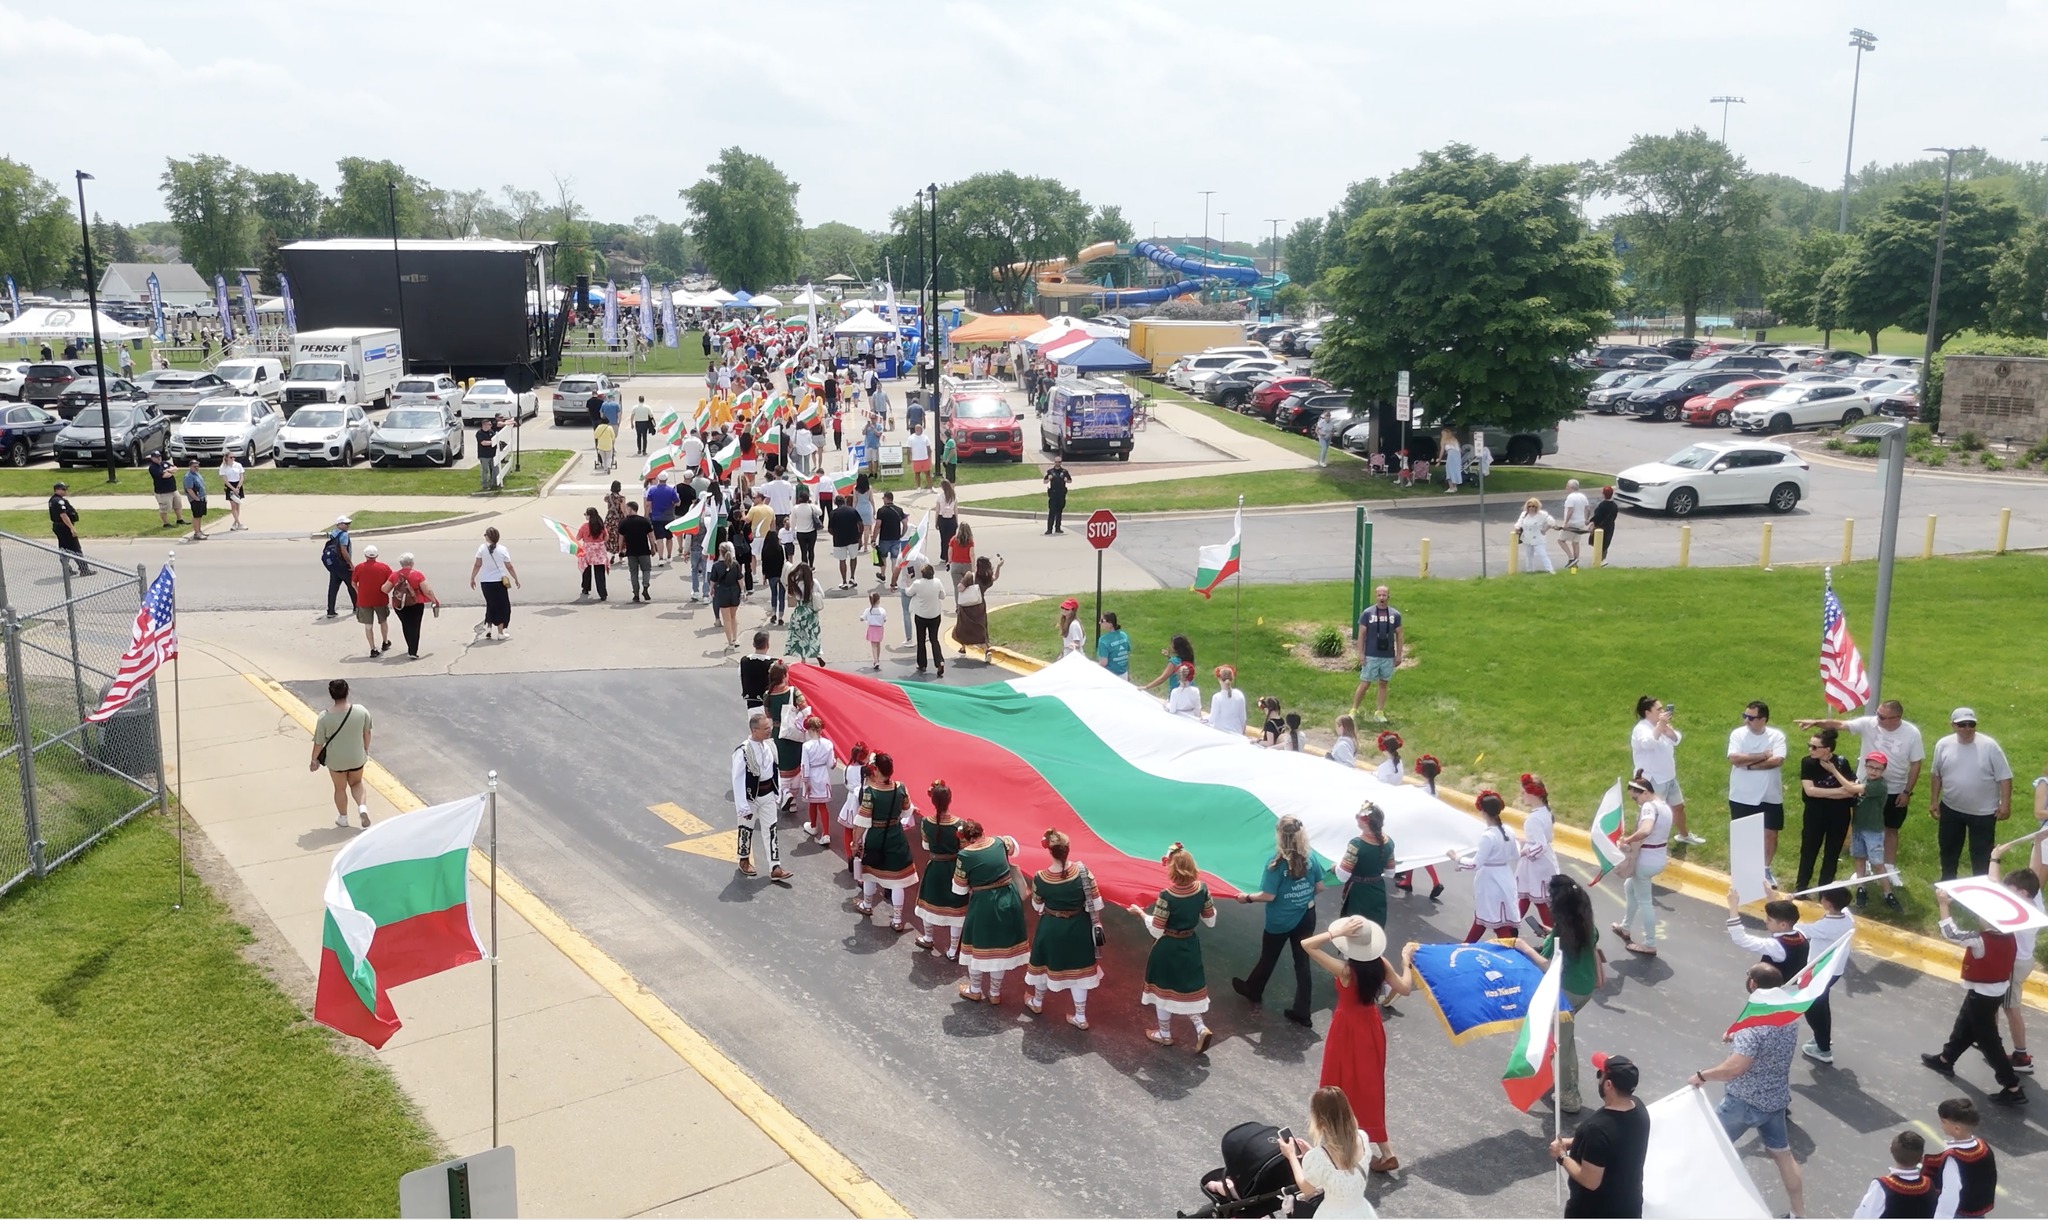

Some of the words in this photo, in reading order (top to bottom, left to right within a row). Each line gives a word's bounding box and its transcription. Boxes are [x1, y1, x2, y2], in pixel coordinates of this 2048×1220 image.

[299, 344, 348, 353] PENSKE
[1088, 521, 1116, 538] STOP
[1291, 882, 1310, 891] white
